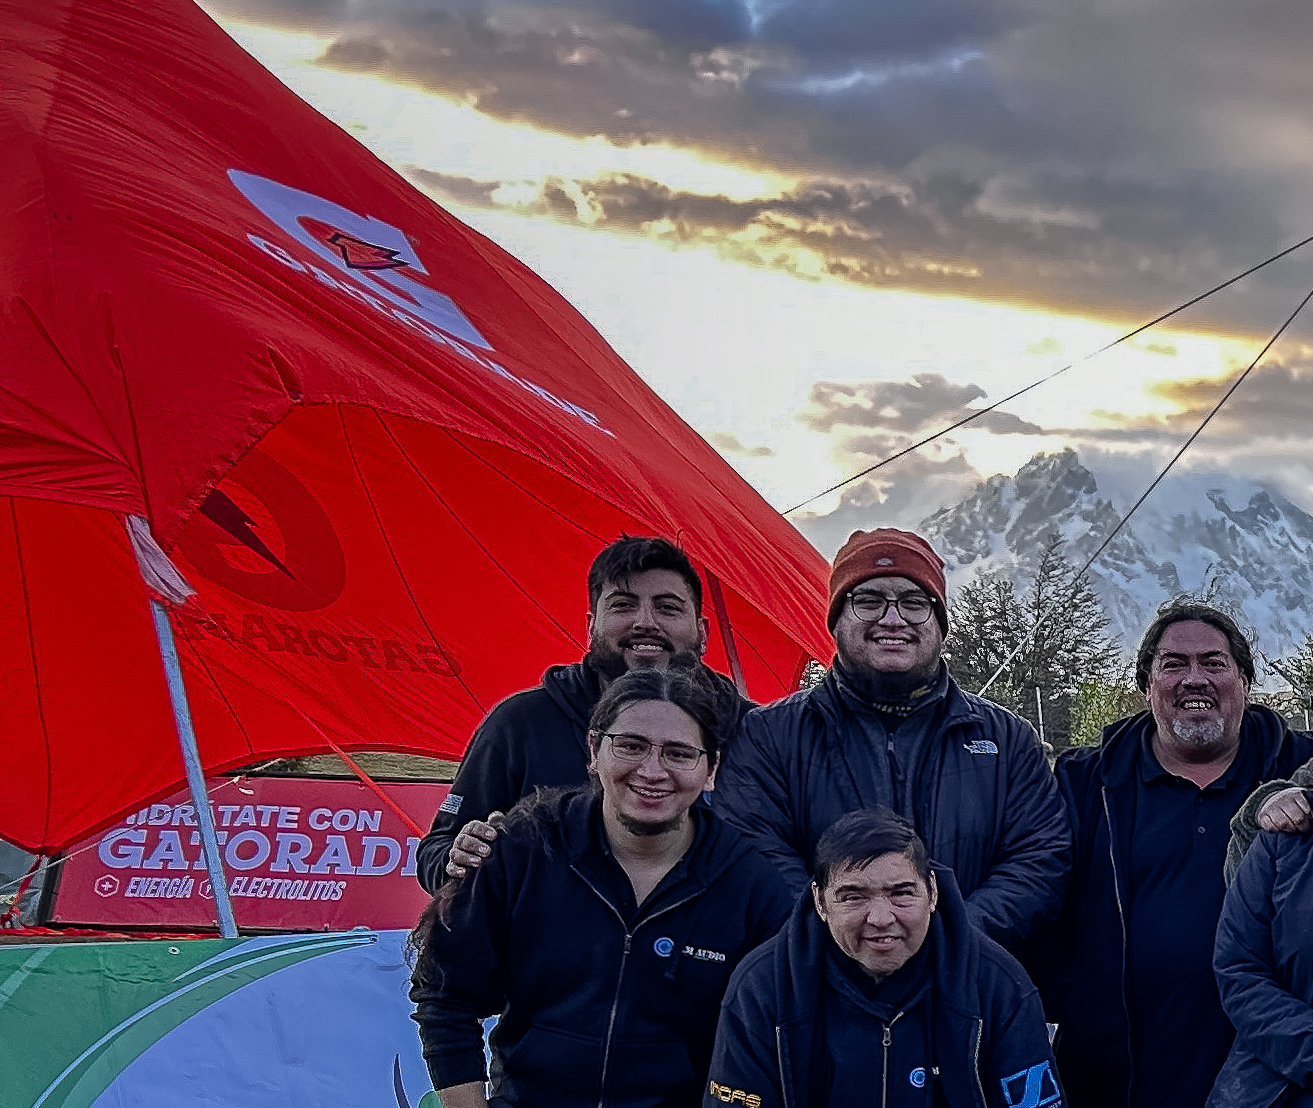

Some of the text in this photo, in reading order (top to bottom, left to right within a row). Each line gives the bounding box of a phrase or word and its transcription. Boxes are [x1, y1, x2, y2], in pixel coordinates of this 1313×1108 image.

[308, 808, 381, 832] CON
[125, 875, 347, 901] ENERGÍA ELECTROLITOS
